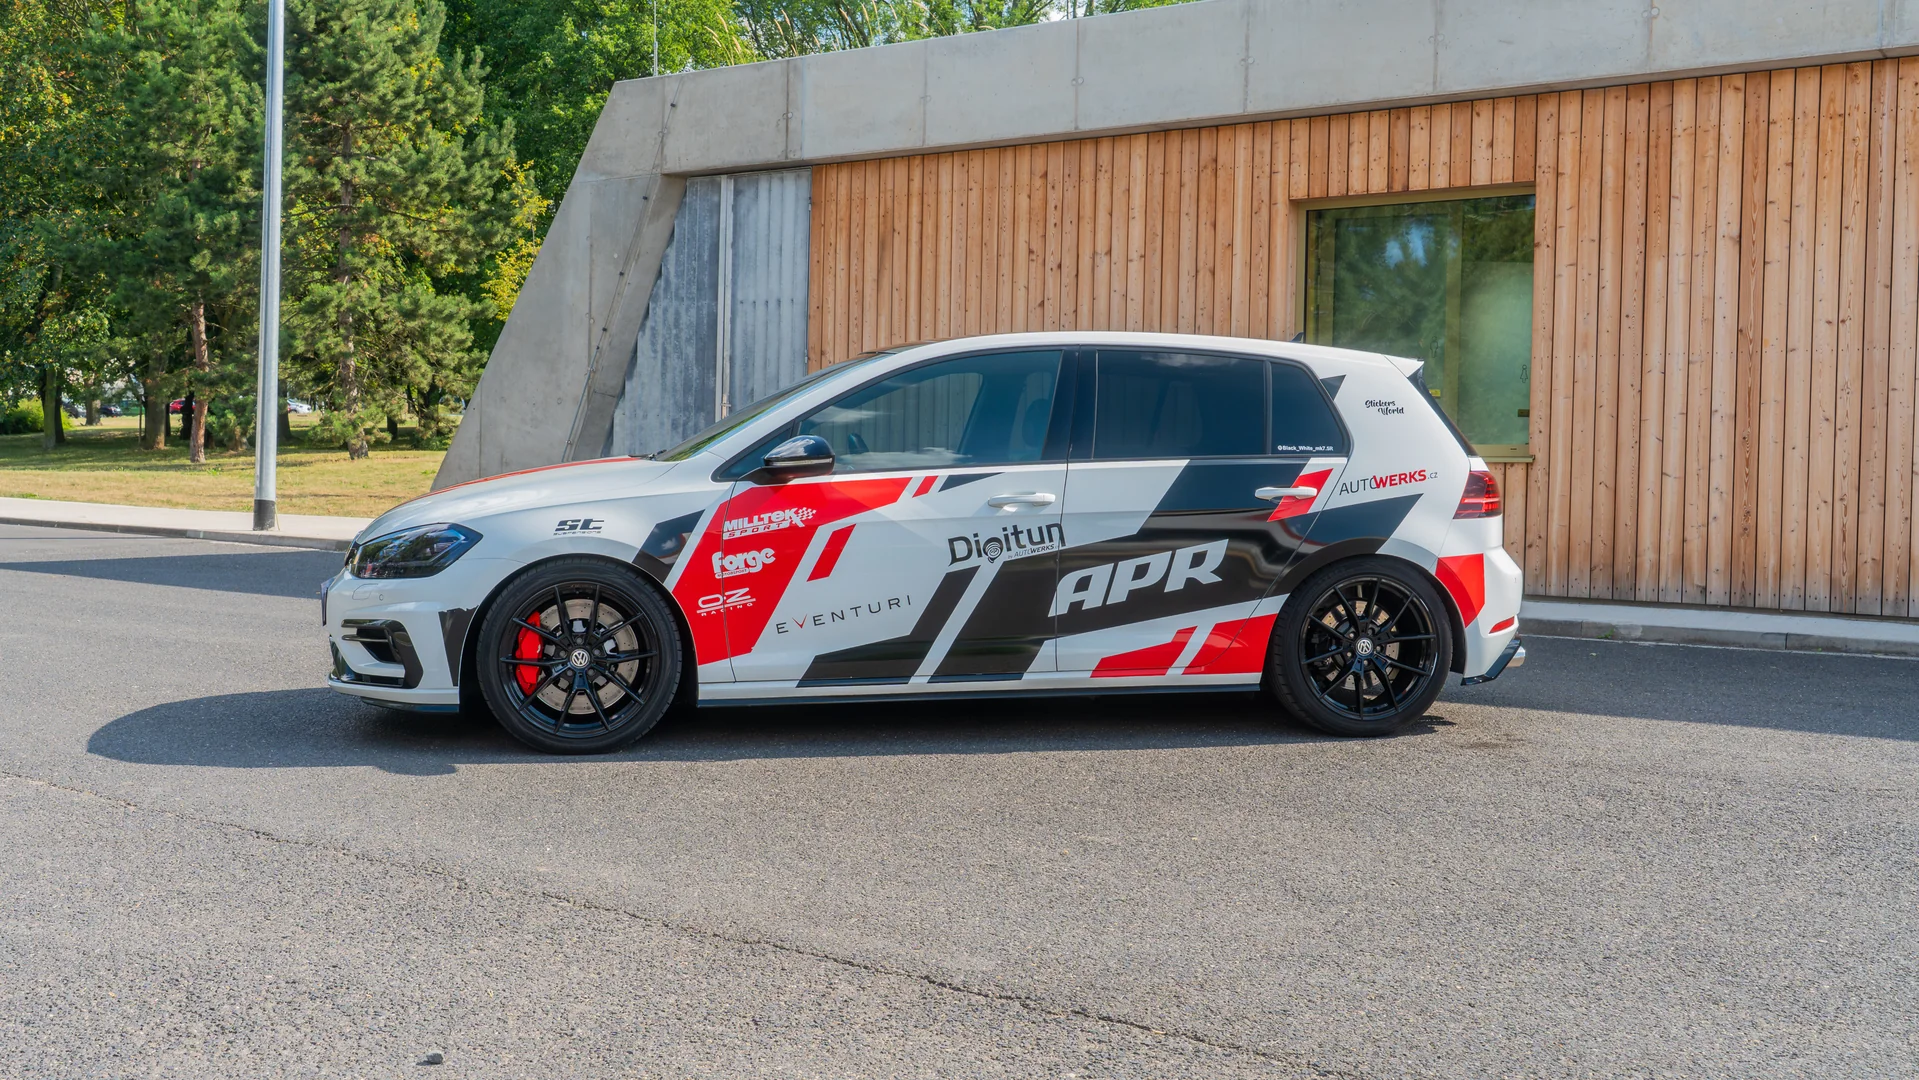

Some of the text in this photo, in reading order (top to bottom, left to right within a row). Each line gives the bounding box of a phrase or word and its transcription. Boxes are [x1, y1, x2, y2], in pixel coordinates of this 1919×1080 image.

[1364, 399, 1396, 409] Stickers
[1377, 406, 1404, 416] World
[727, 522, 782, 538] SPORT
[1047, 538, 1230, 618] APR
[700, 602, 753, 617] RACING
[775, 594, 912, 635] EVENTURI
